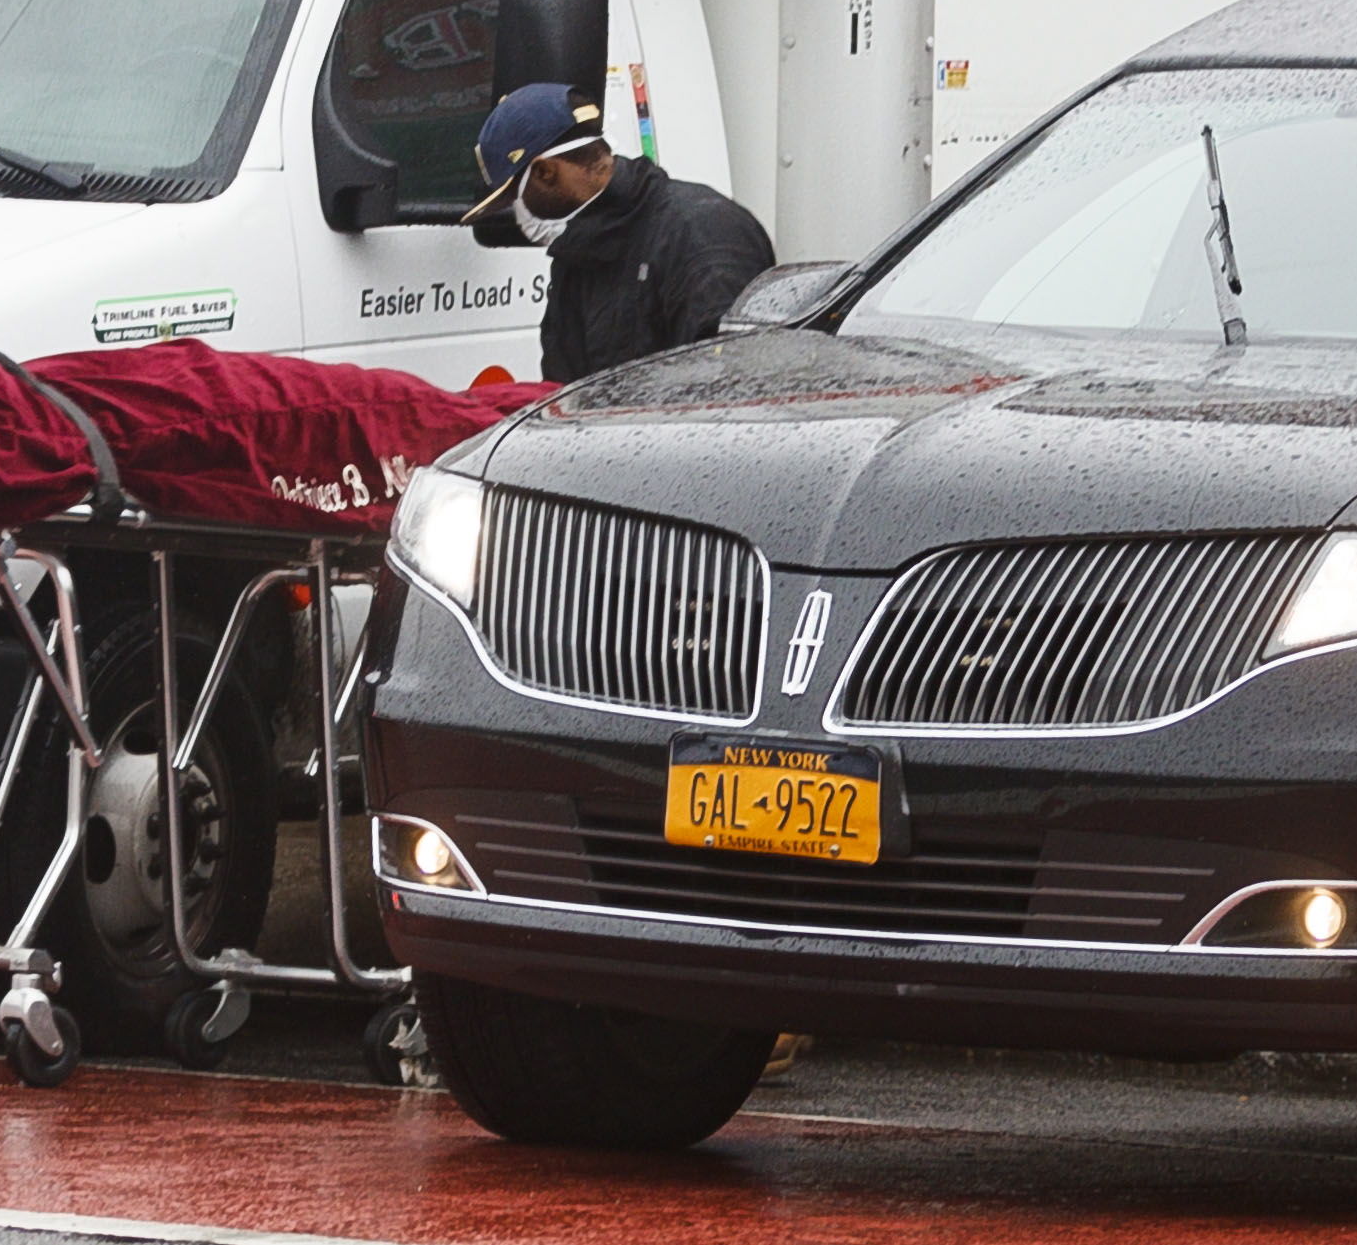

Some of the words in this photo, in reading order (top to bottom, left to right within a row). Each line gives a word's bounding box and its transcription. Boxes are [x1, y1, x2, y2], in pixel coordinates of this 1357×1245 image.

[360, 286, 425, 318] Easier
[431, 282, 455, 313] To
[461, 276, 512, 310] Load
[103, 308, 156, 323] TRIMLINE
[160, 305, 189, 318] FUEL
[192, 300, 228, 315] SAVER
[724, 745, 773, 766] NEW
[777, 750, 831, 773] YORK
[690, 771, 747, 830] GAL
[775, 778, 859, 839] 9522
[717, 833, 774, 853] EMPIRE
[780, 837, 828, 856] STATE
